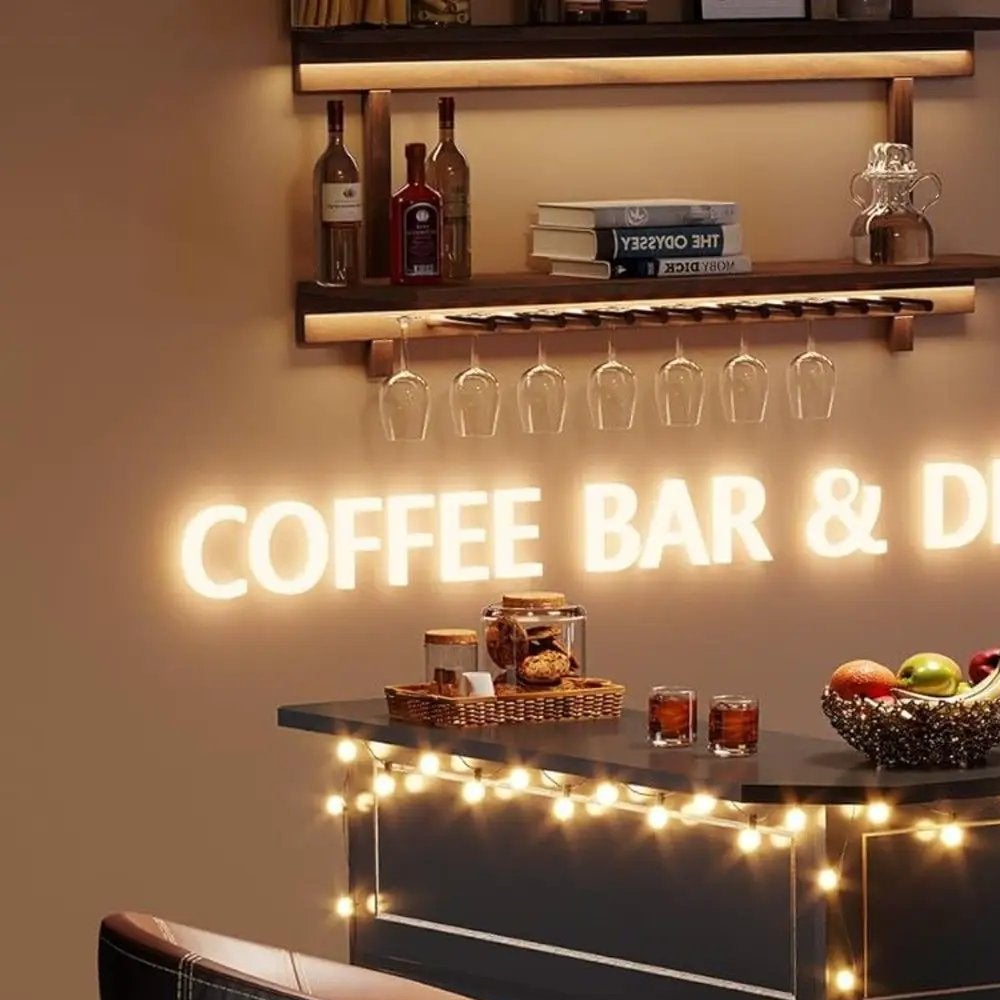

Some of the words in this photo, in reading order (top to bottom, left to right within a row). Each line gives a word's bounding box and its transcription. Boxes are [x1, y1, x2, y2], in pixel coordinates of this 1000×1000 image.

[180, 487, 544, 600] COFFEE
[583, 475, 773, 573] BAR
[804, 466, 888, 559] &
